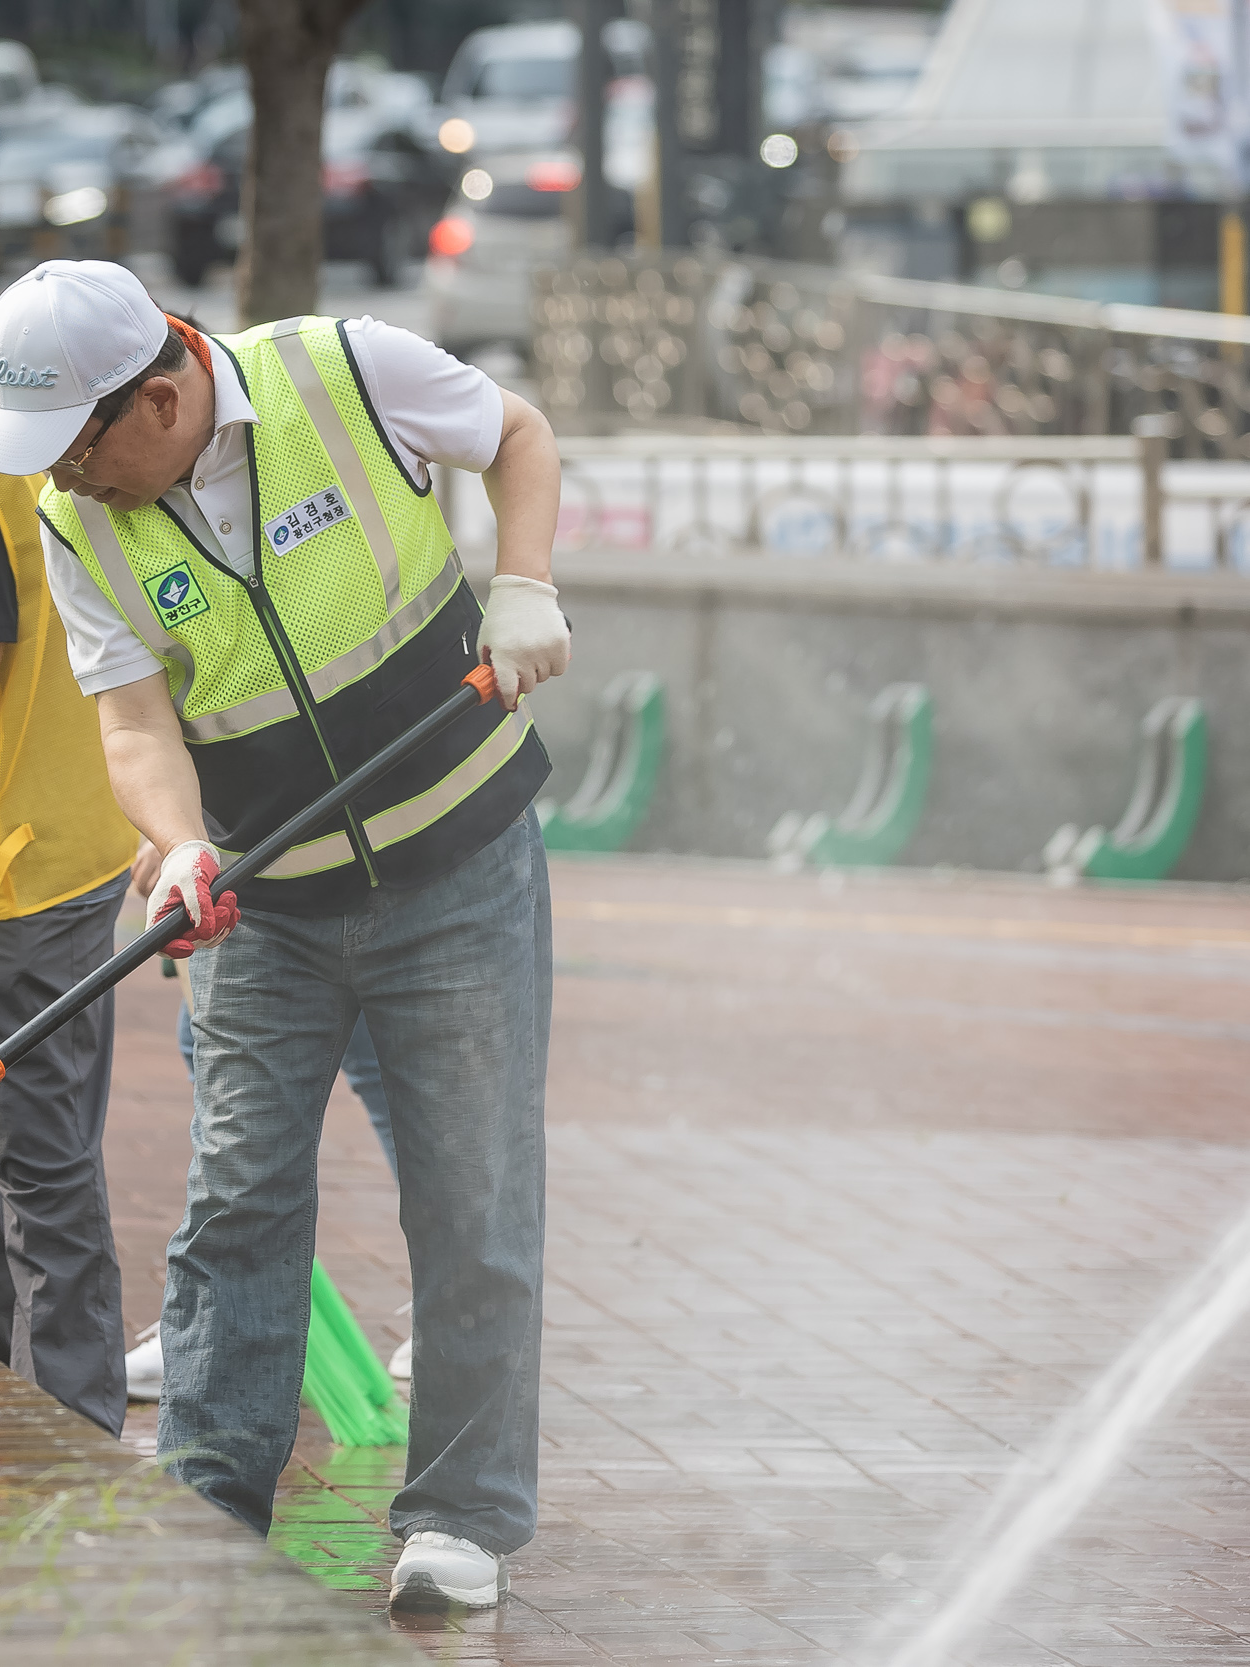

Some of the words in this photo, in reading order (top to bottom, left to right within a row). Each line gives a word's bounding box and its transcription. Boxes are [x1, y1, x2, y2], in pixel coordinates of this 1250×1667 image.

[87, 361, 127, 392] PRO
[127, 345, 148, 364] V1
[293, 505, 344, 539] 광진구청장
[165, 598, 201, 621] 광진구
